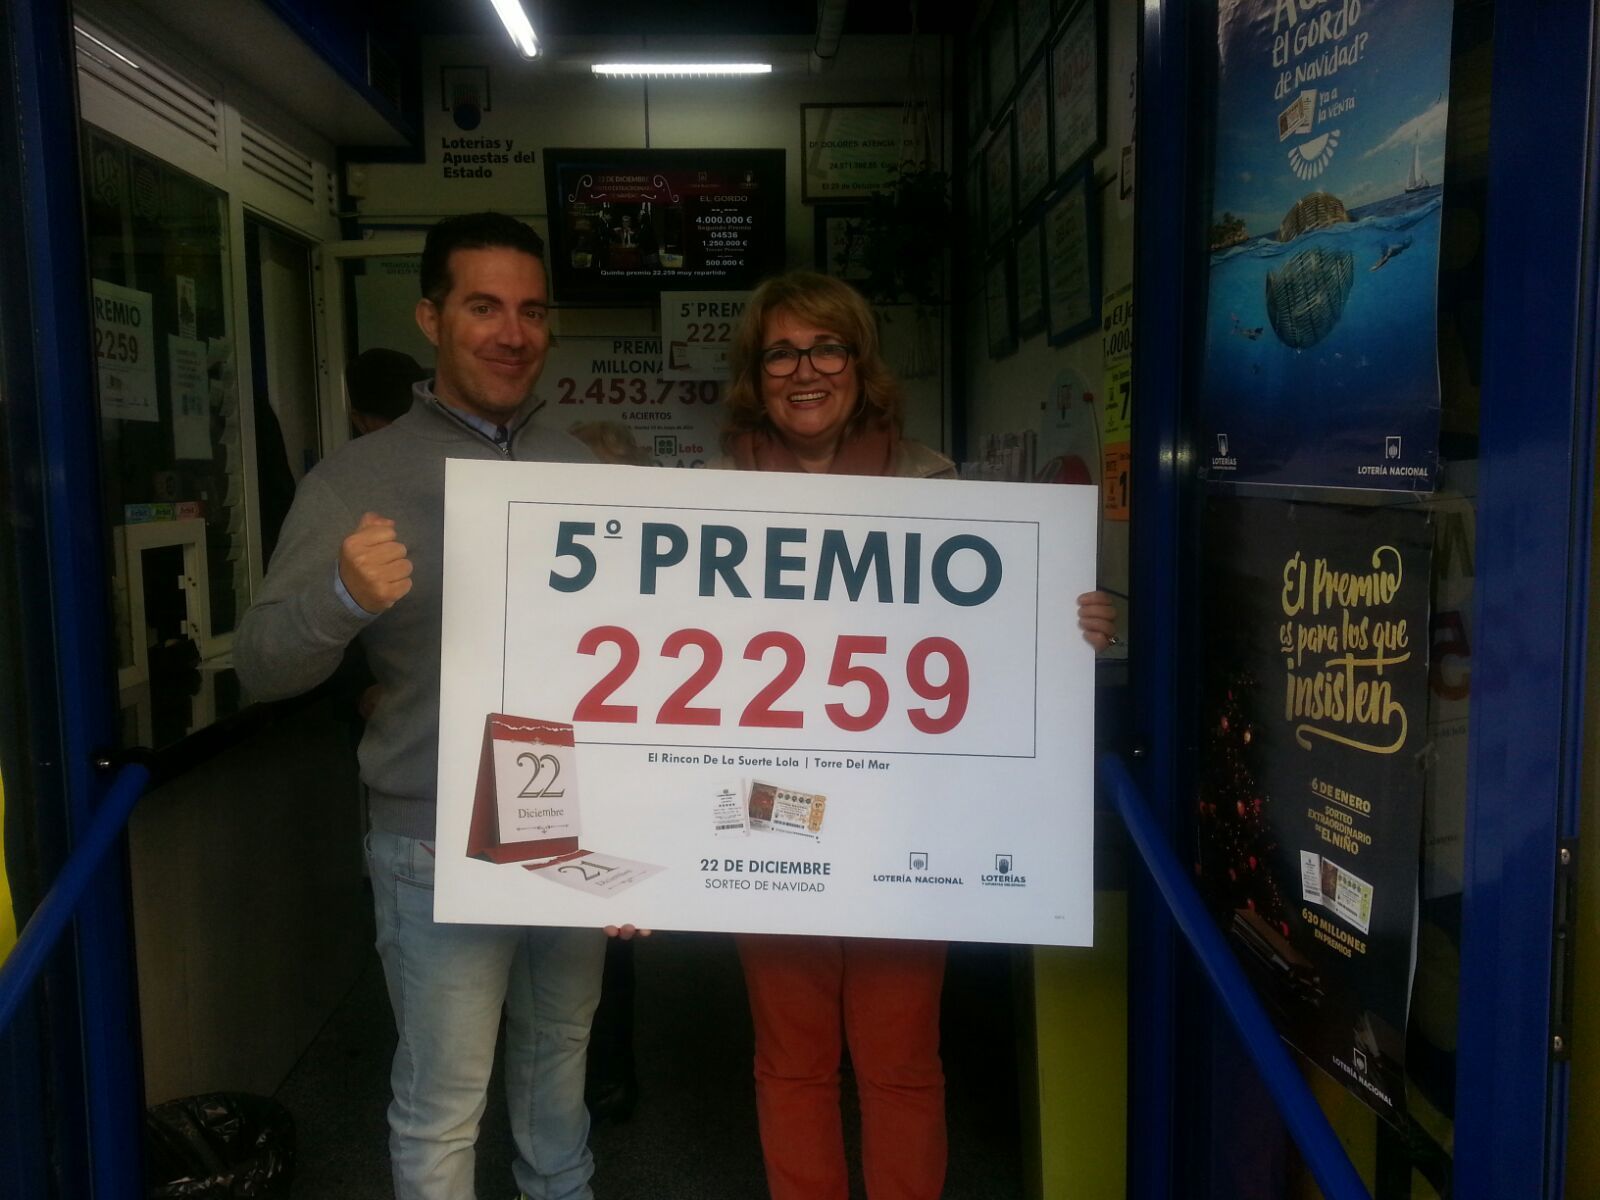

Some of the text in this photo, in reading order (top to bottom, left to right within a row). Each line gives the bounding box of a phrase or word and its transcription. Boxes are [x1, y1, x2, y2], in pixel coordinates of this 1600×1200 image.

[1272, 30, 1288, 68] el
[1274, 32, 1368, 100] de Navidad?
[506, 140, 514, 151] y
[443, 152, 535, 166] Apuestas del
[444, 166, 492, 178] Estado
[696, 216, 753, 224] 4.000.000 €
[558, 378, 720, 404] 2.453.730
[622, 412, 672, 420] 6 ACIERTOS
[679, 444, 704, 453] Loto
[1358, 464, 1428, 478] LOTERÍA NACIONAL
[549, 520, 1002, 606] 5º PREMIO
[1312, 545, 1402, 615] Premio
[1298, 623, 1338, 667] para
[1343, 608, 1368, 650] los
[1372, 618, 1408, 676] que
[572, 625, 970, 734] 22259
[1286, 652, 1411, 754] insisten
[648, 752, 658, 763] El
[662, 753, 700, 764] Rincon
[704, 754, 718, 765] De
[722, 755, 734, 765] La
[738, 756, 772, 766] Suerte
[776, 756, 799, 767] Lola
[814, 758, 842, 768] Torre
[846, 758, 864, 769] Del
[868, 759, 890, 770] Mar
[516, 752, 565, 798] 22
[1311, 776, 1372, 814] 6 DE ENERO
[518, 807, 564, 819] Diciembre
[1324, 805, 1353, 826] SORTEO
[1308, 808, 1372, 846] EXTRAORDINARIO
[1332, 830, 1359, 856] NIÑO
[700, 858, 831, 875] 22 DE DICIEMBRE
[705, 878, 825, 892] SORTEO DE NAVIDAD
[873, 874, 964, 885] LOTERÍA NACIONAL
[982, 874, 1026, 883] LOTERÍAS
[1302, 908, 1367, 955] 630 MILLONES
[1358, 1076, 1393, 1107] NACIONAL
